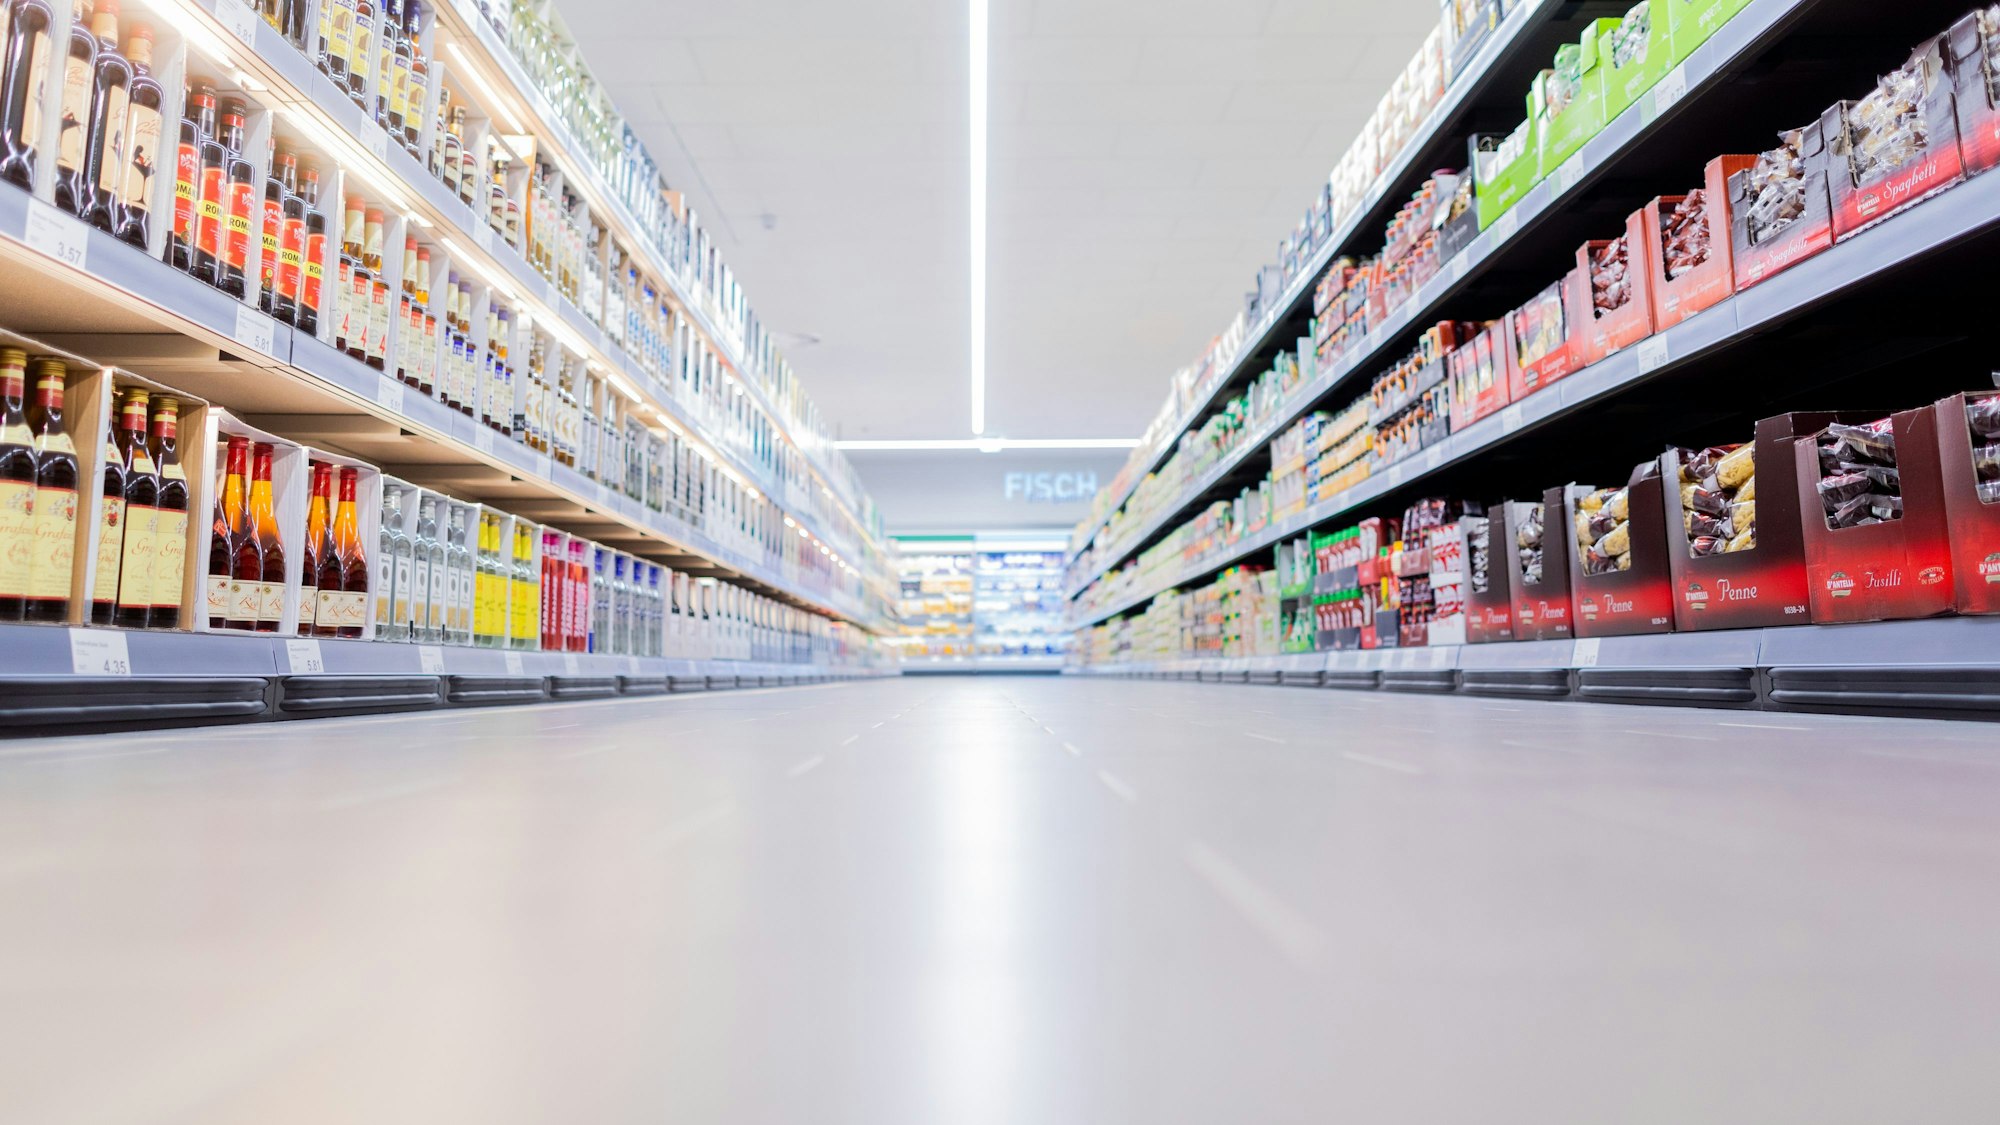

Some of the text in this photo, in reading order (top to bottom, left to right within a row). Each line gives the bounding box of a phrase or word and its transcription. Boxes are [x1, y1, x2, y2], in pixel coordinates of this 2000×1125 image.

[1884, 160, 1937, 201] Spaghetti
[57, 241, 82, 264] 3.57
[254, 335, 270, 352] 5.81
[1005, 472, 1097, 499] FISCH
[1865, 569, 1902, 588] Fusilli
[1717, 578, 1757, 602] Penne
[1539, 601, 1565, 619] Penne
[1603, 594, 1633, 613] Penne
[104, 659, 127, 674] 4.35
[307, 660, 321, 671] 5.81
